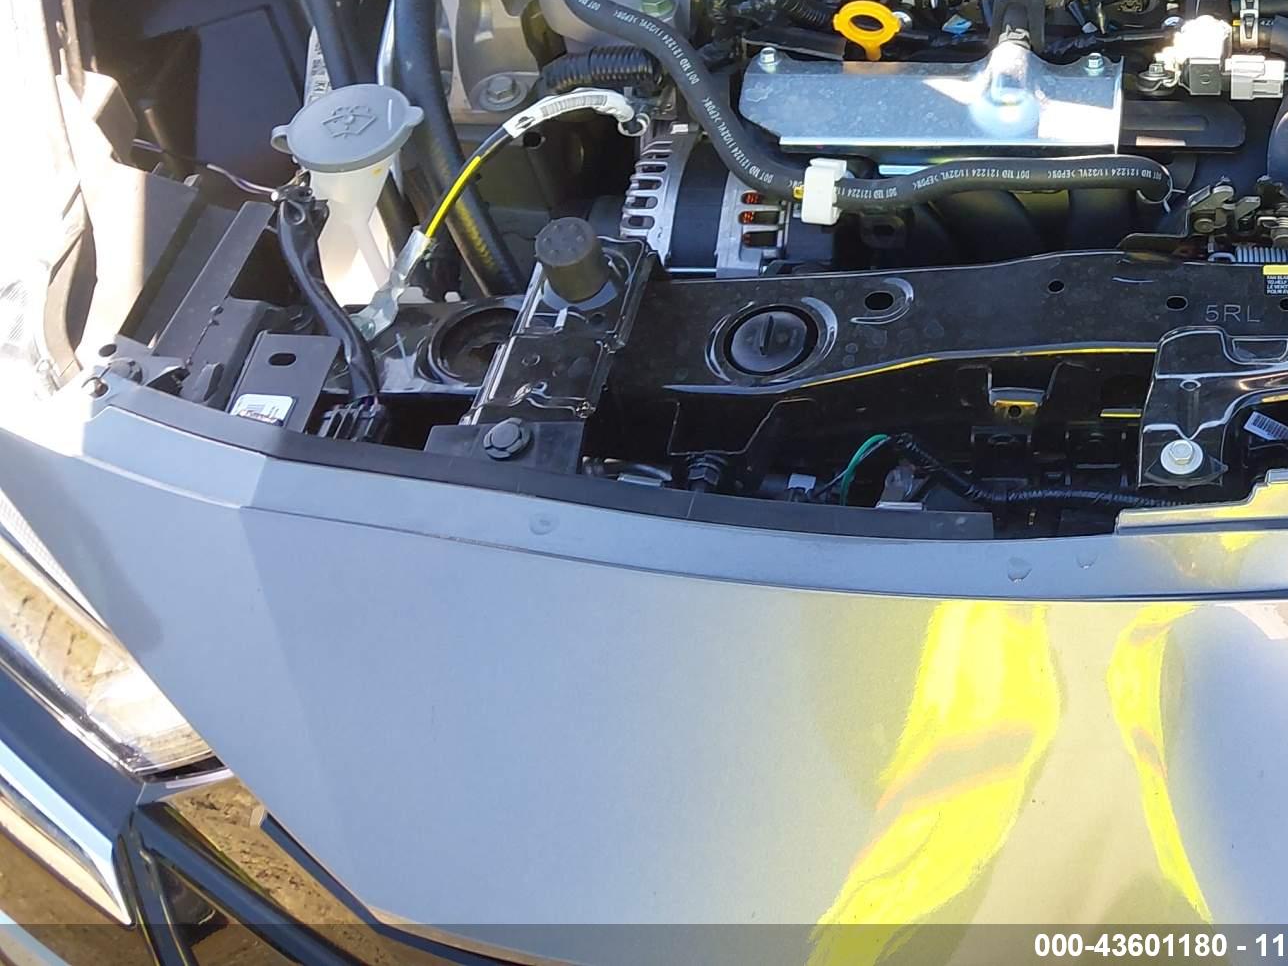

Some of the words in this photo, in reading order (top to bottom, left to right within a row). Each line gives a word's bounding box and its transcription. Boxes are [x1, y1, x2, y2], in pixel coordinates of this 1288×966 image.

[760, 170, 774, 184] DOT
[972, 169, 1000, 179] 121224
[1016, 170, 1030, 179] DOT
[1111, 168, 1139, 178] 121224
[1206, 304, 1260, 322] 5RL
